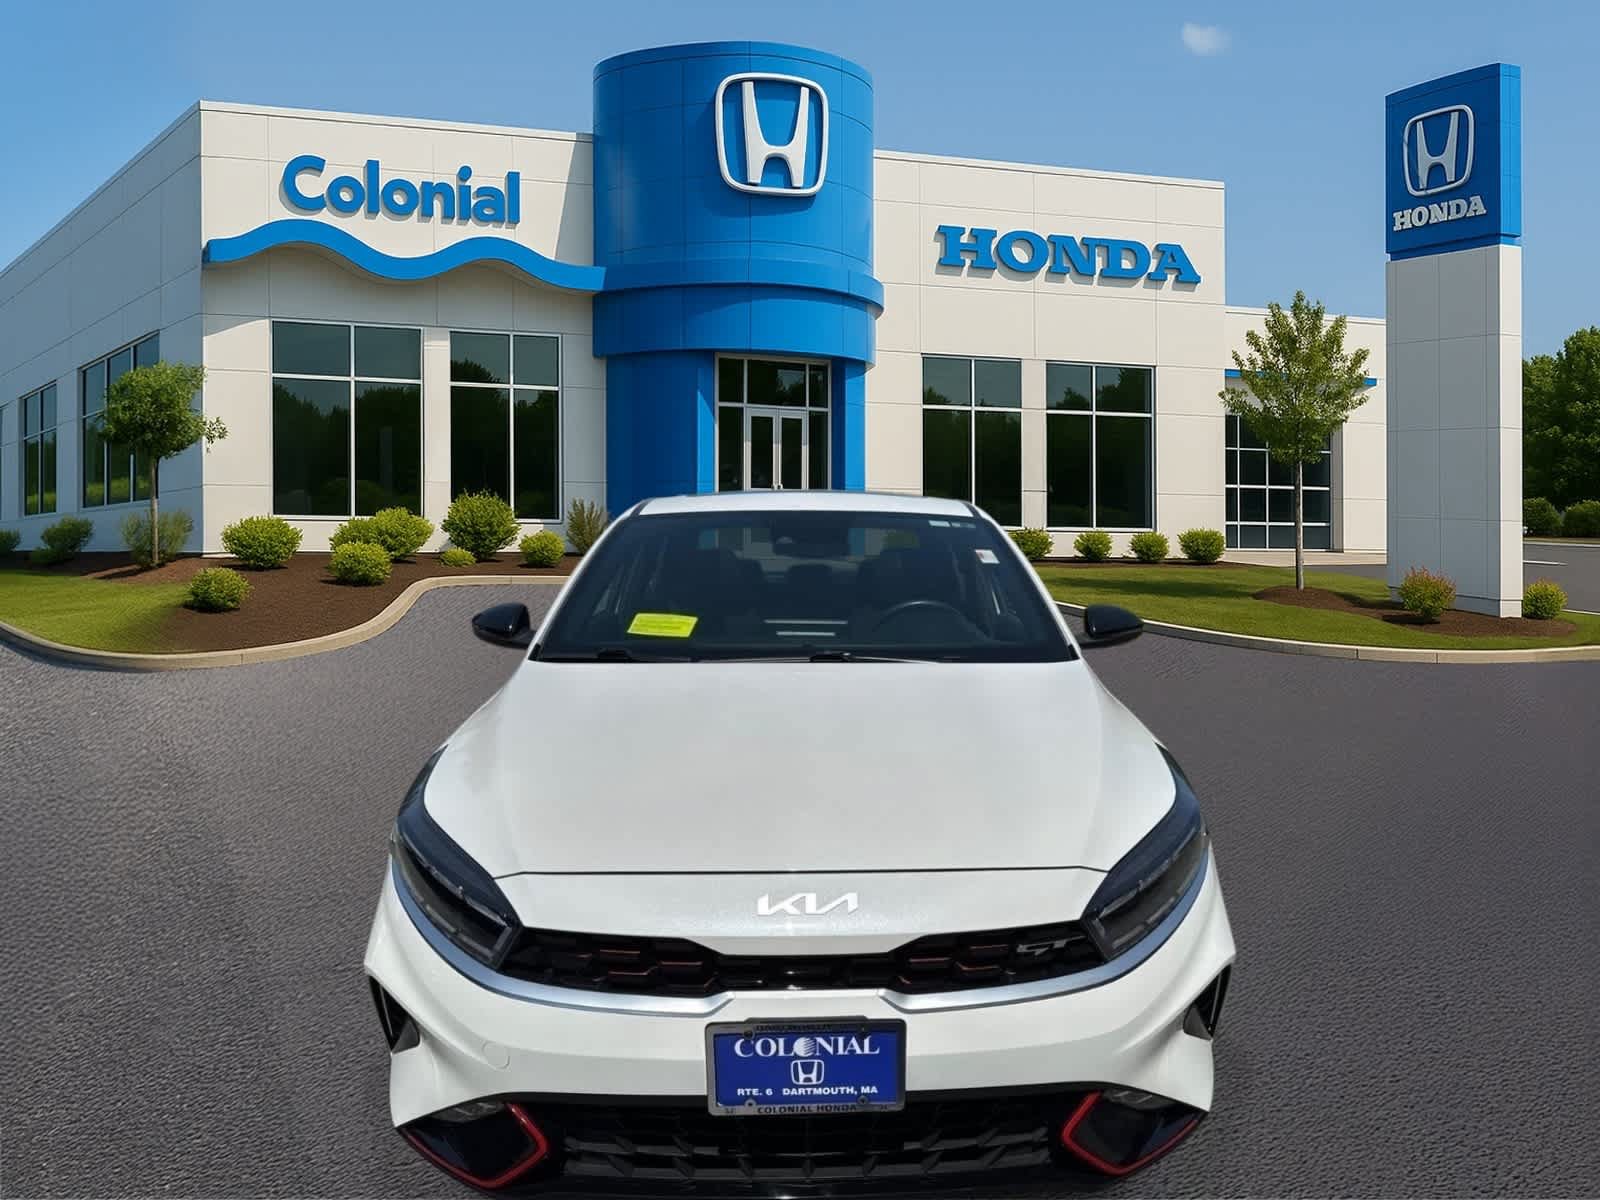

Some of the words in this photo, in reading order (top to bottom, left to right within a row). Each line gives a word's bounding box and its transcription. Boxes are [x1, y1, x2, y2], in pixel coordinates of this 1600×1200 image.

[282, 154, 520, 225] Colonial
[1392, 195, 1487, 232] HONDA
[936, 224, 1202, 284] HONDA
[734, 1036, 880, 1058] COLONIAL
[737, 1088, 763, 1096] RTE.
[765, 1088, 773, 1096] 6
[782, 1086, 858, 1096] DARTMOUTH,
[860, 1086, 878, 1094] MA
[757, 1104, 813, 1114] COLONIAL
[816, 1103, 857, 1113] HONDA
